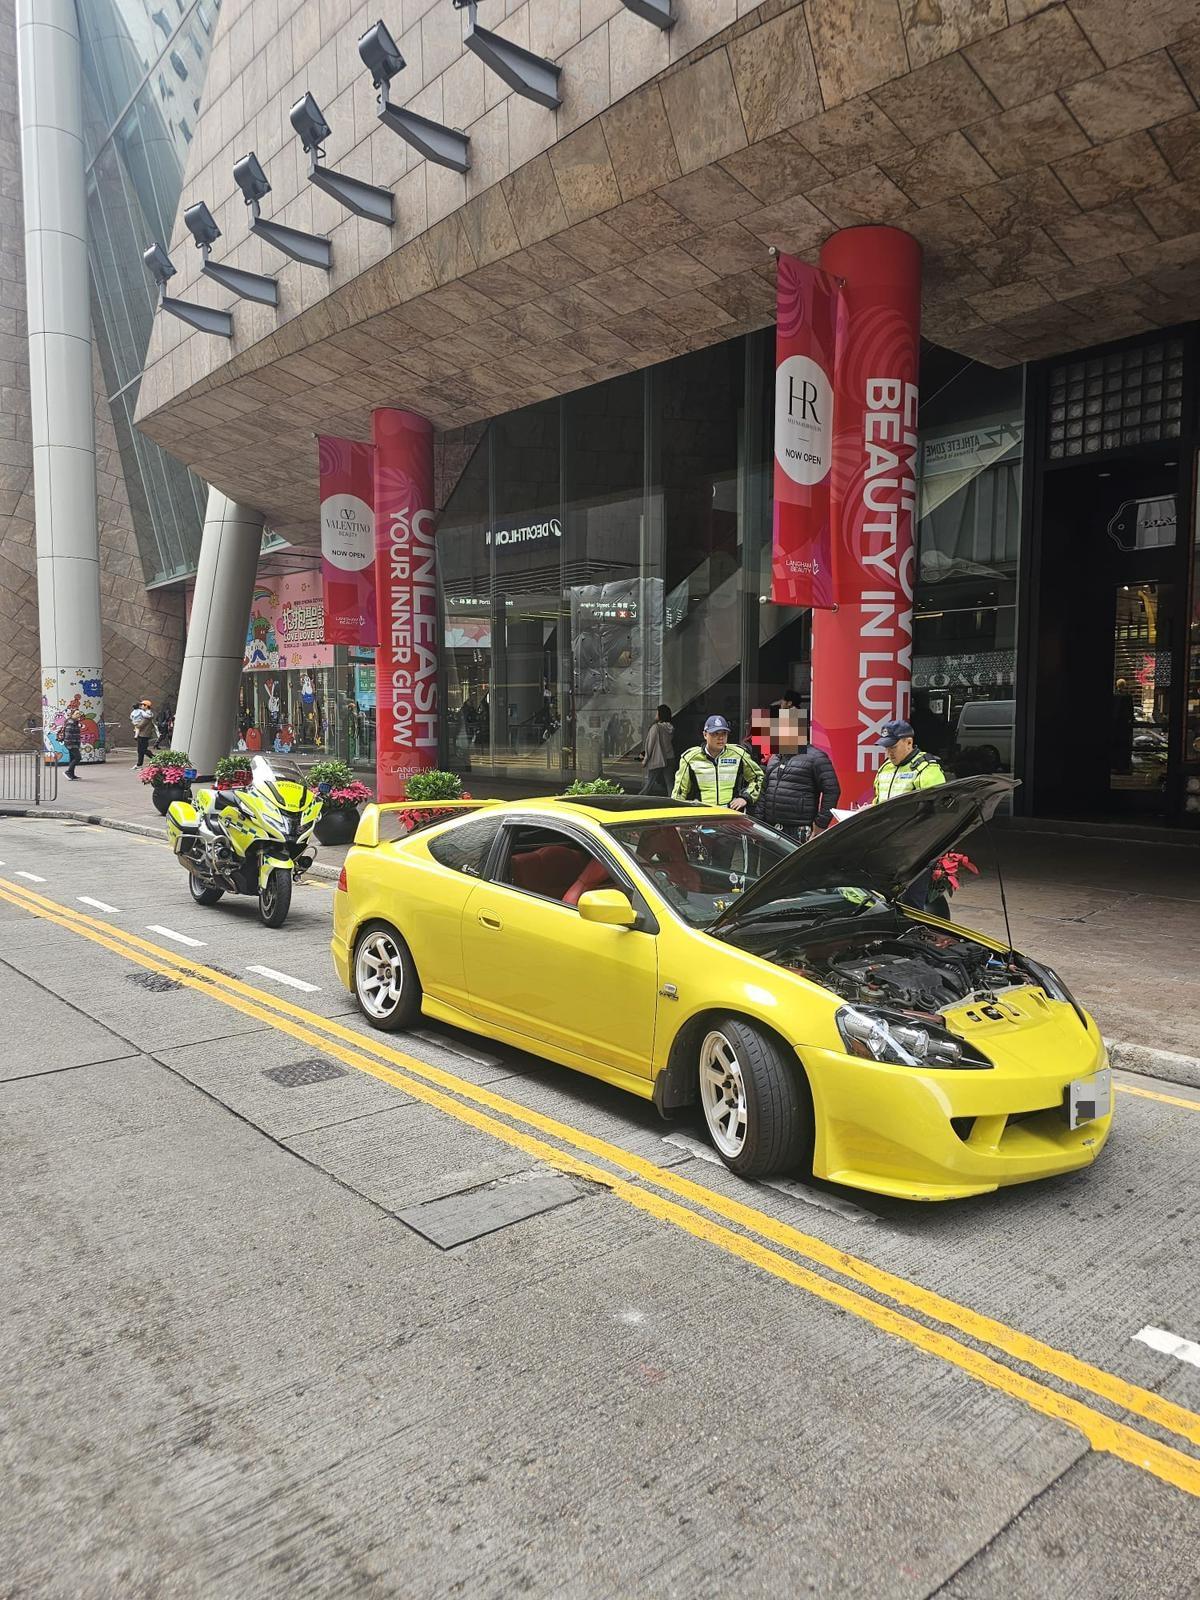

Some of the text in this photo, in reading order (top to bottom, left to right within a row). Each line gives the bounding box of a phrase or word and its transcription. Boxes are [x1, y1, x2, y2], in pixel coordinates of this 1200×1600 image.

[788, 375, 822, 425] HR
[785, 447, 822, 465] NOW OPEN
[862, 378, 901, 578] BEAUTY
[325, 518, 371, 534] VALENTINO
[331, 549, 366, 559] NOW OPEN
[389, 506, 410, 580] YOUR
[284, 632, 299, 643] LOVE
[299, 631, 316, 641] LOVE
[391, 585, 411, 664] INNER
[411, 508, 438, 747] UNLEASH
[860, 591, 896, 637] IN
[392, 670, 413, 748] GLOW
[857, 652, 894, 772] LUXE
